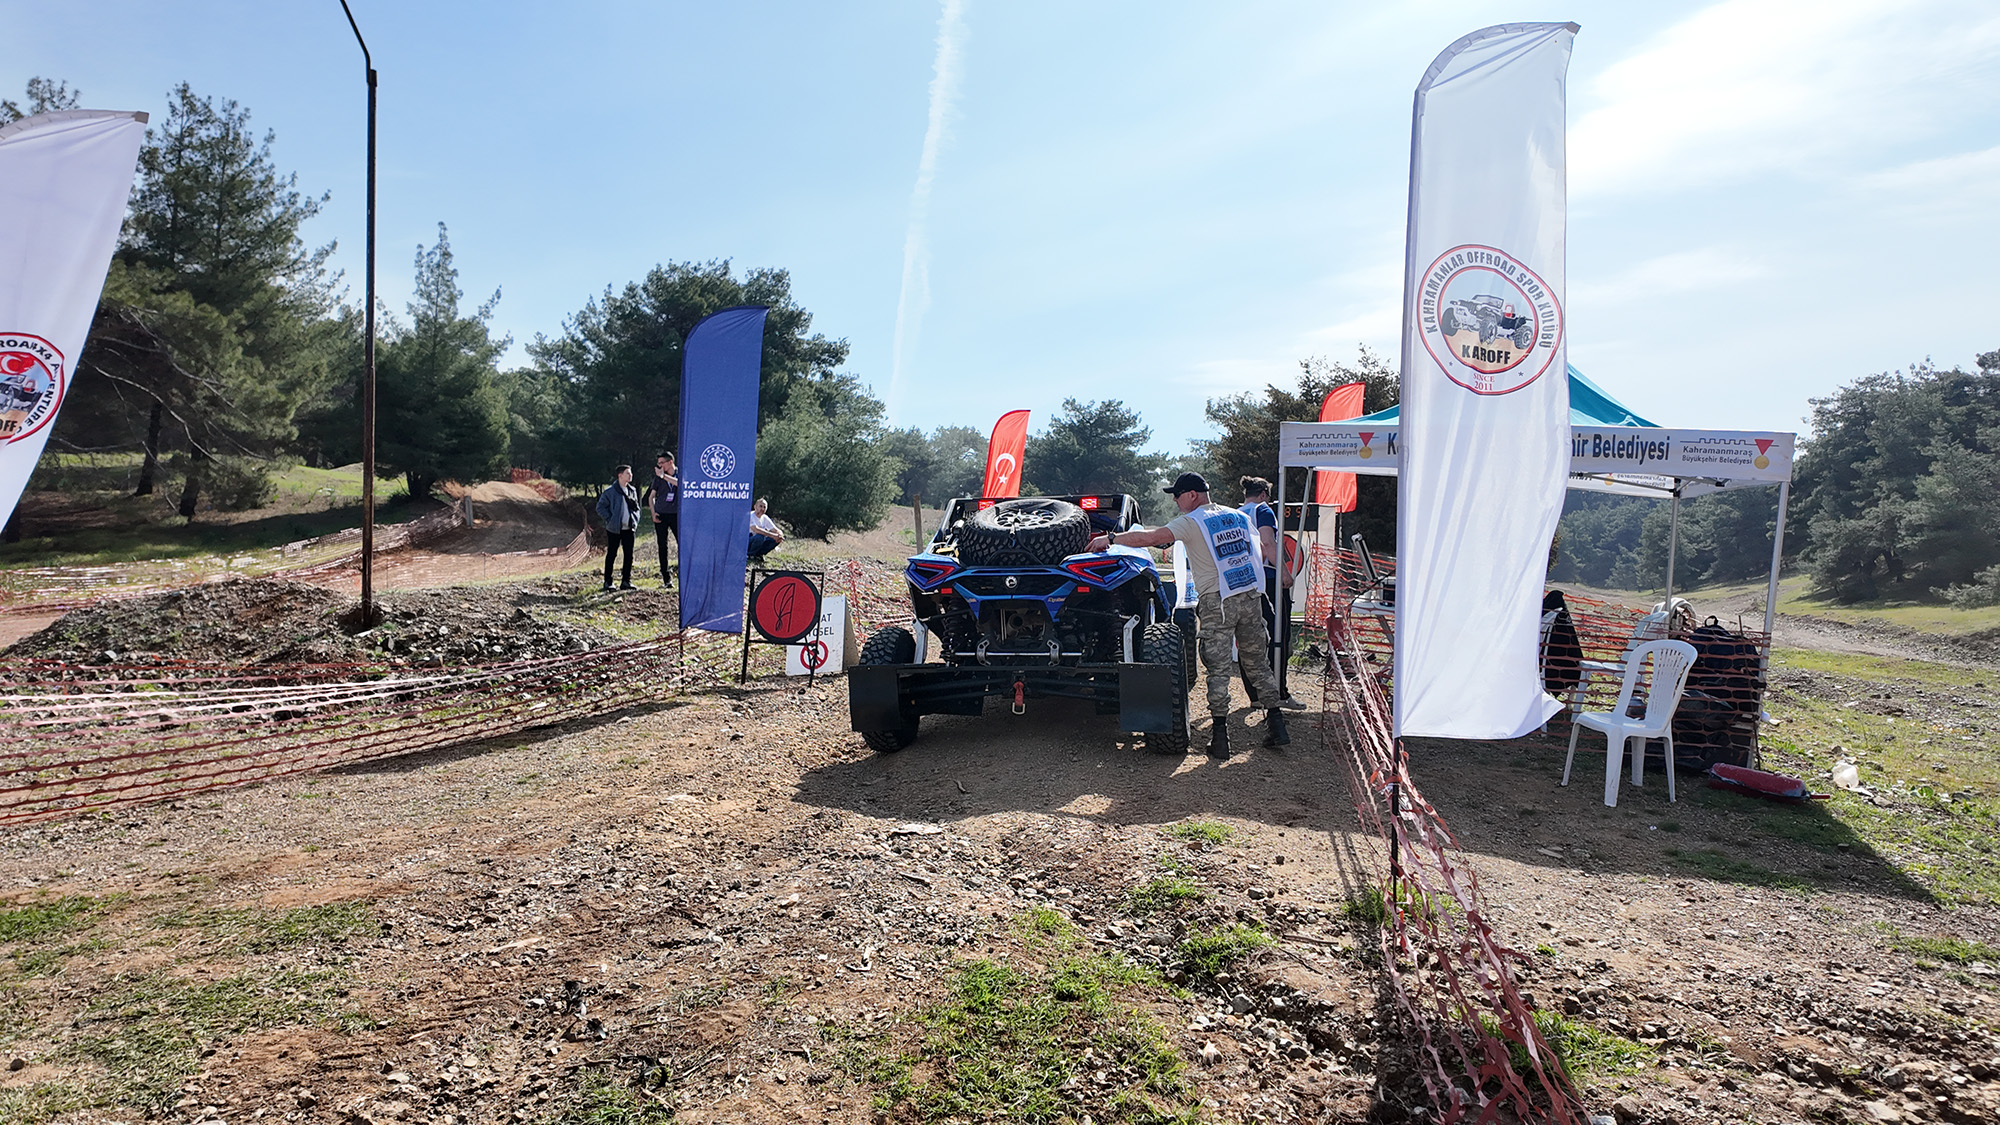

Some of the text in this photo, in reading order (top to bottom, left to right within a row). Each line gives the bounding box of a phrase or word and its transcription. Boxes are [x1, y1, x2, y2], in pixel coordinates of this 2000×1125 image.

[1422, 251, 1559, 349] KAHRAMANLAR OFFROAD SPOR KULÜBÜ
[1461, 344, 1511, 364] KAROFF
[1473, 372, 1496, 382] SINCE
[1474, 381, 1493, 391] 2011
[1299, 441, 1358, 449] Kahramanmaraş
[1592, 433, 1670, 466] Belediyesi
[1330, 449, 1358, 457] Belediyesi
[1683, 445, 1753, 457] Kahramanmaraş
[1682, 454, 1752, 466] Büyükşehir Belediyesi
[683, 481, 750, 491] T.C. GENÇLİK VE
[683, 490, 704, 499] SPOR
[706, 490, 749, 499] BAKANLIĞI
